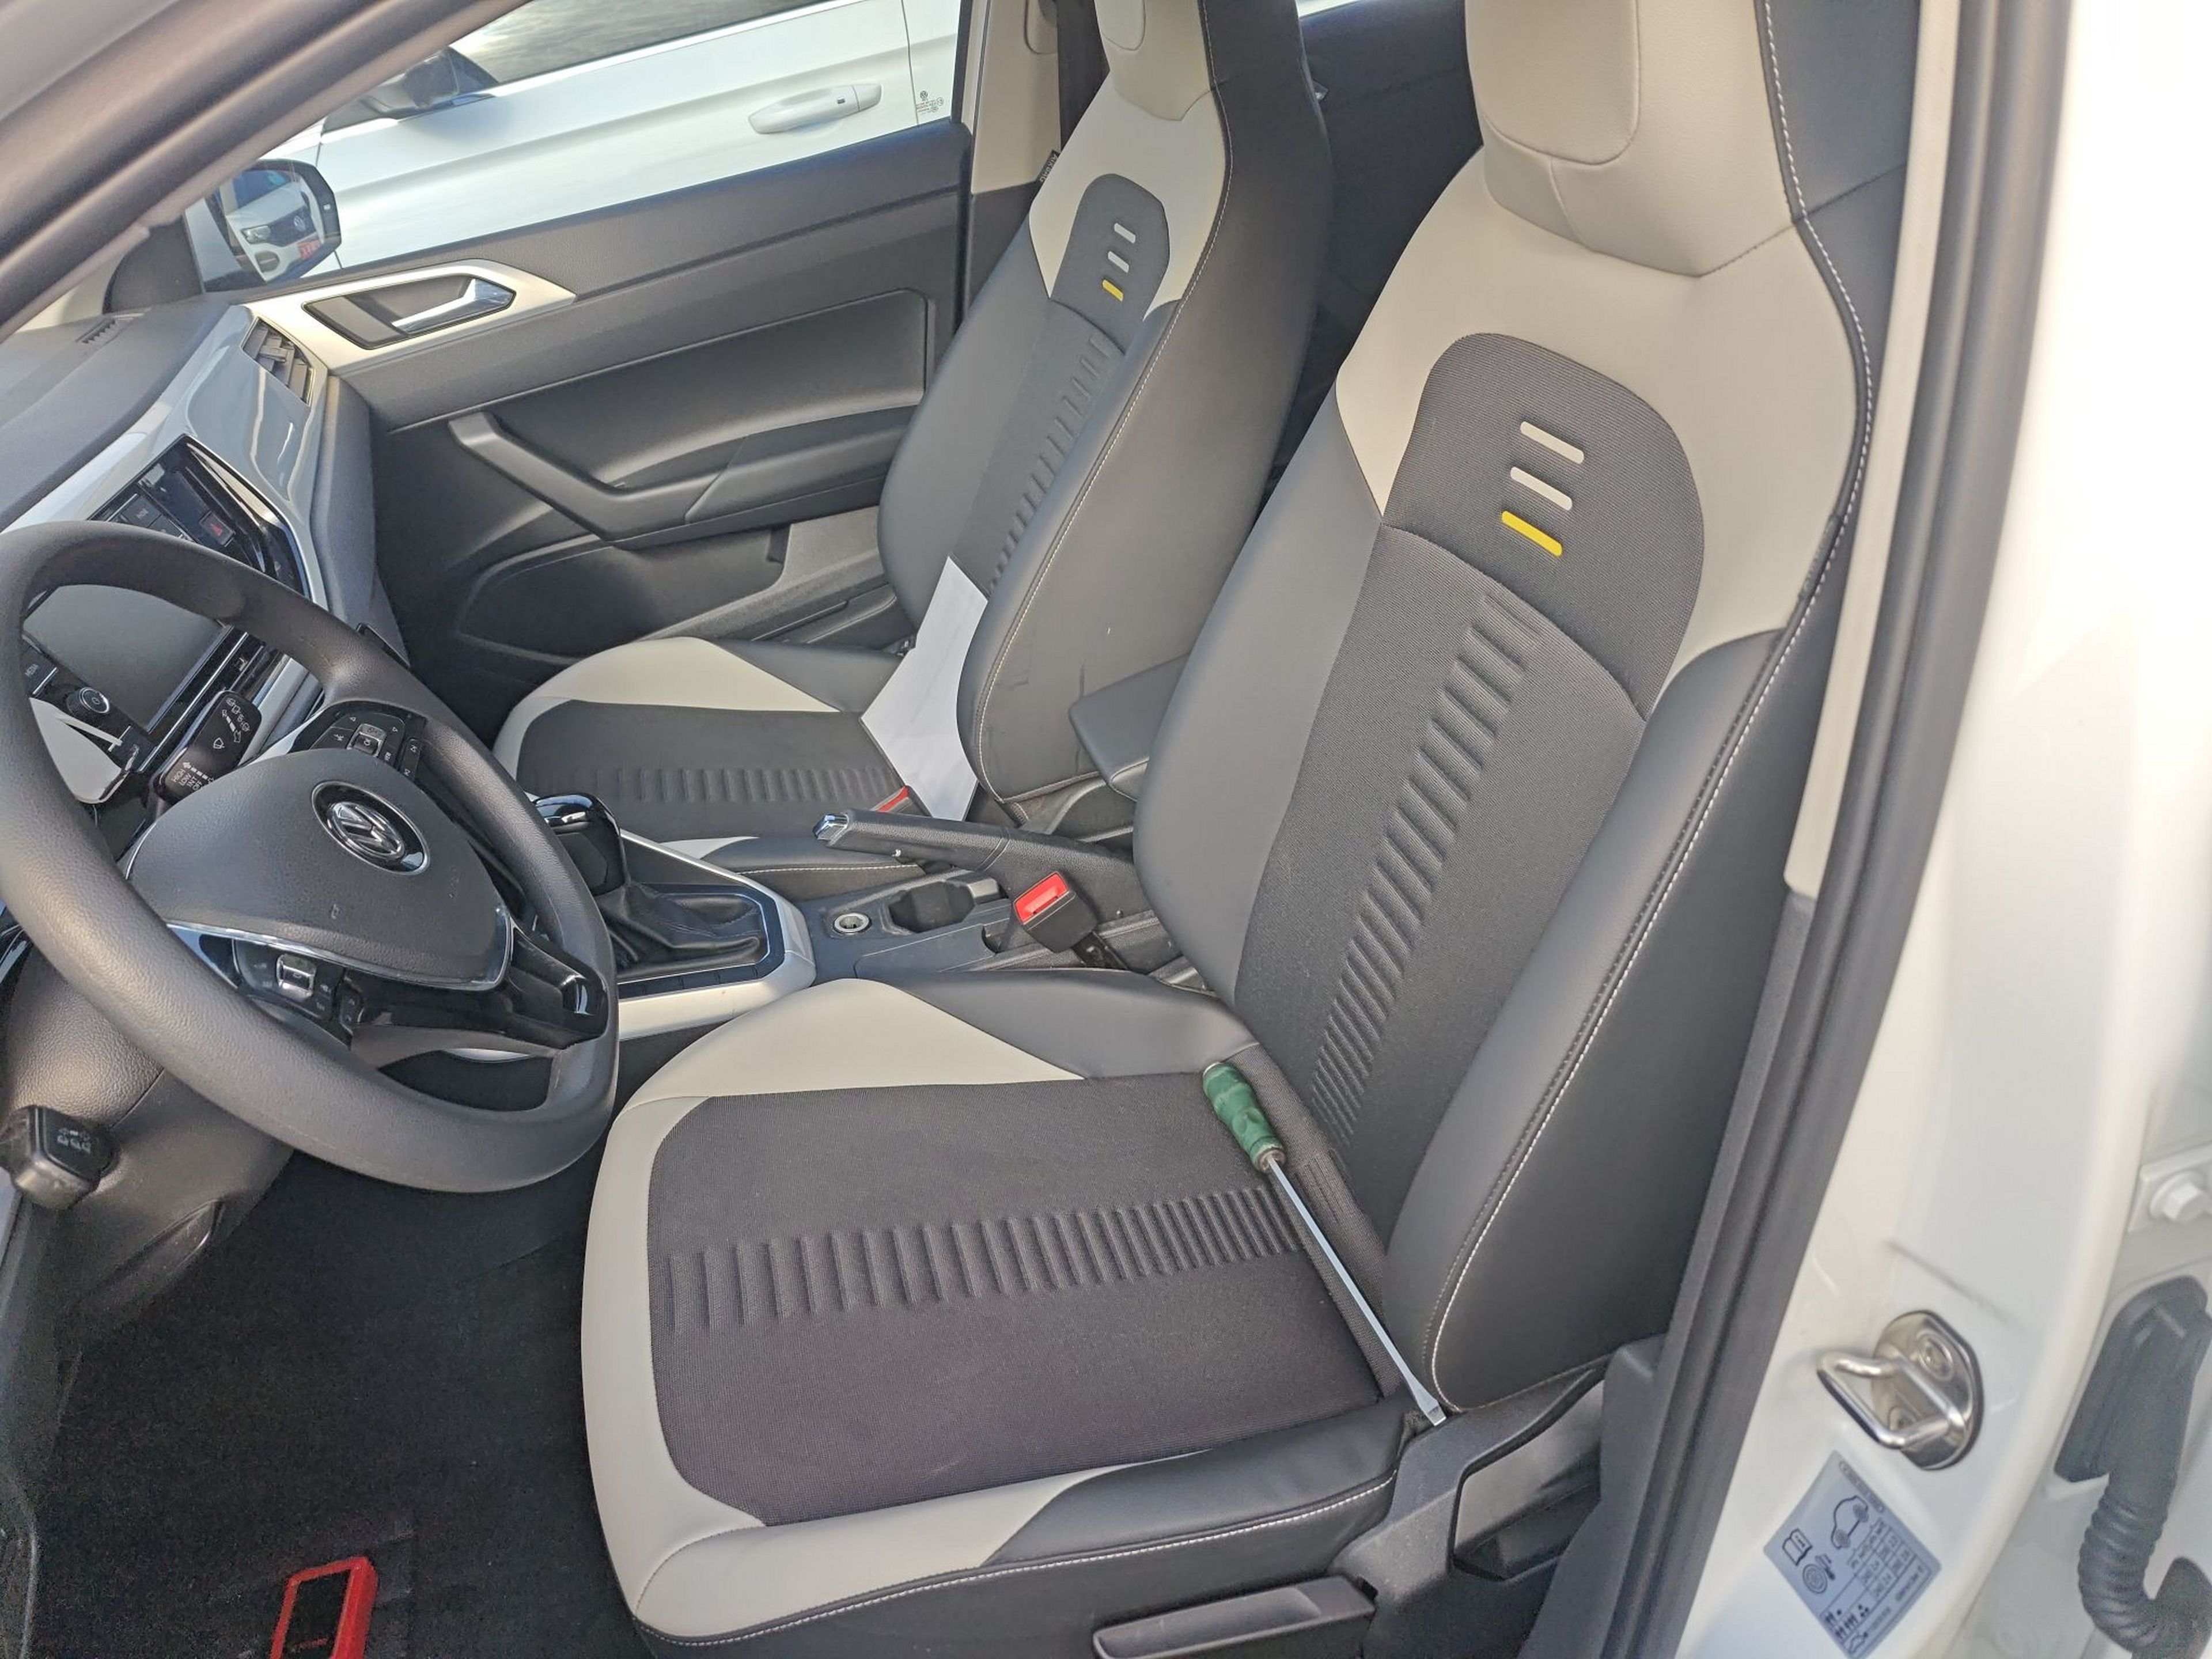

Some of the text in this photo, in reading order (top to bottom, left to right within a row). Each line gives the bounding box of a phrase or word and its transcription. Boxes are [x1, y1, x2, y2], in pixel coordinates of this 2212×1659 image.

[172, 768, 186, 783] HIGH
[179, 773, 191, 786] LOW
[186, 776, 198, 787] INT
